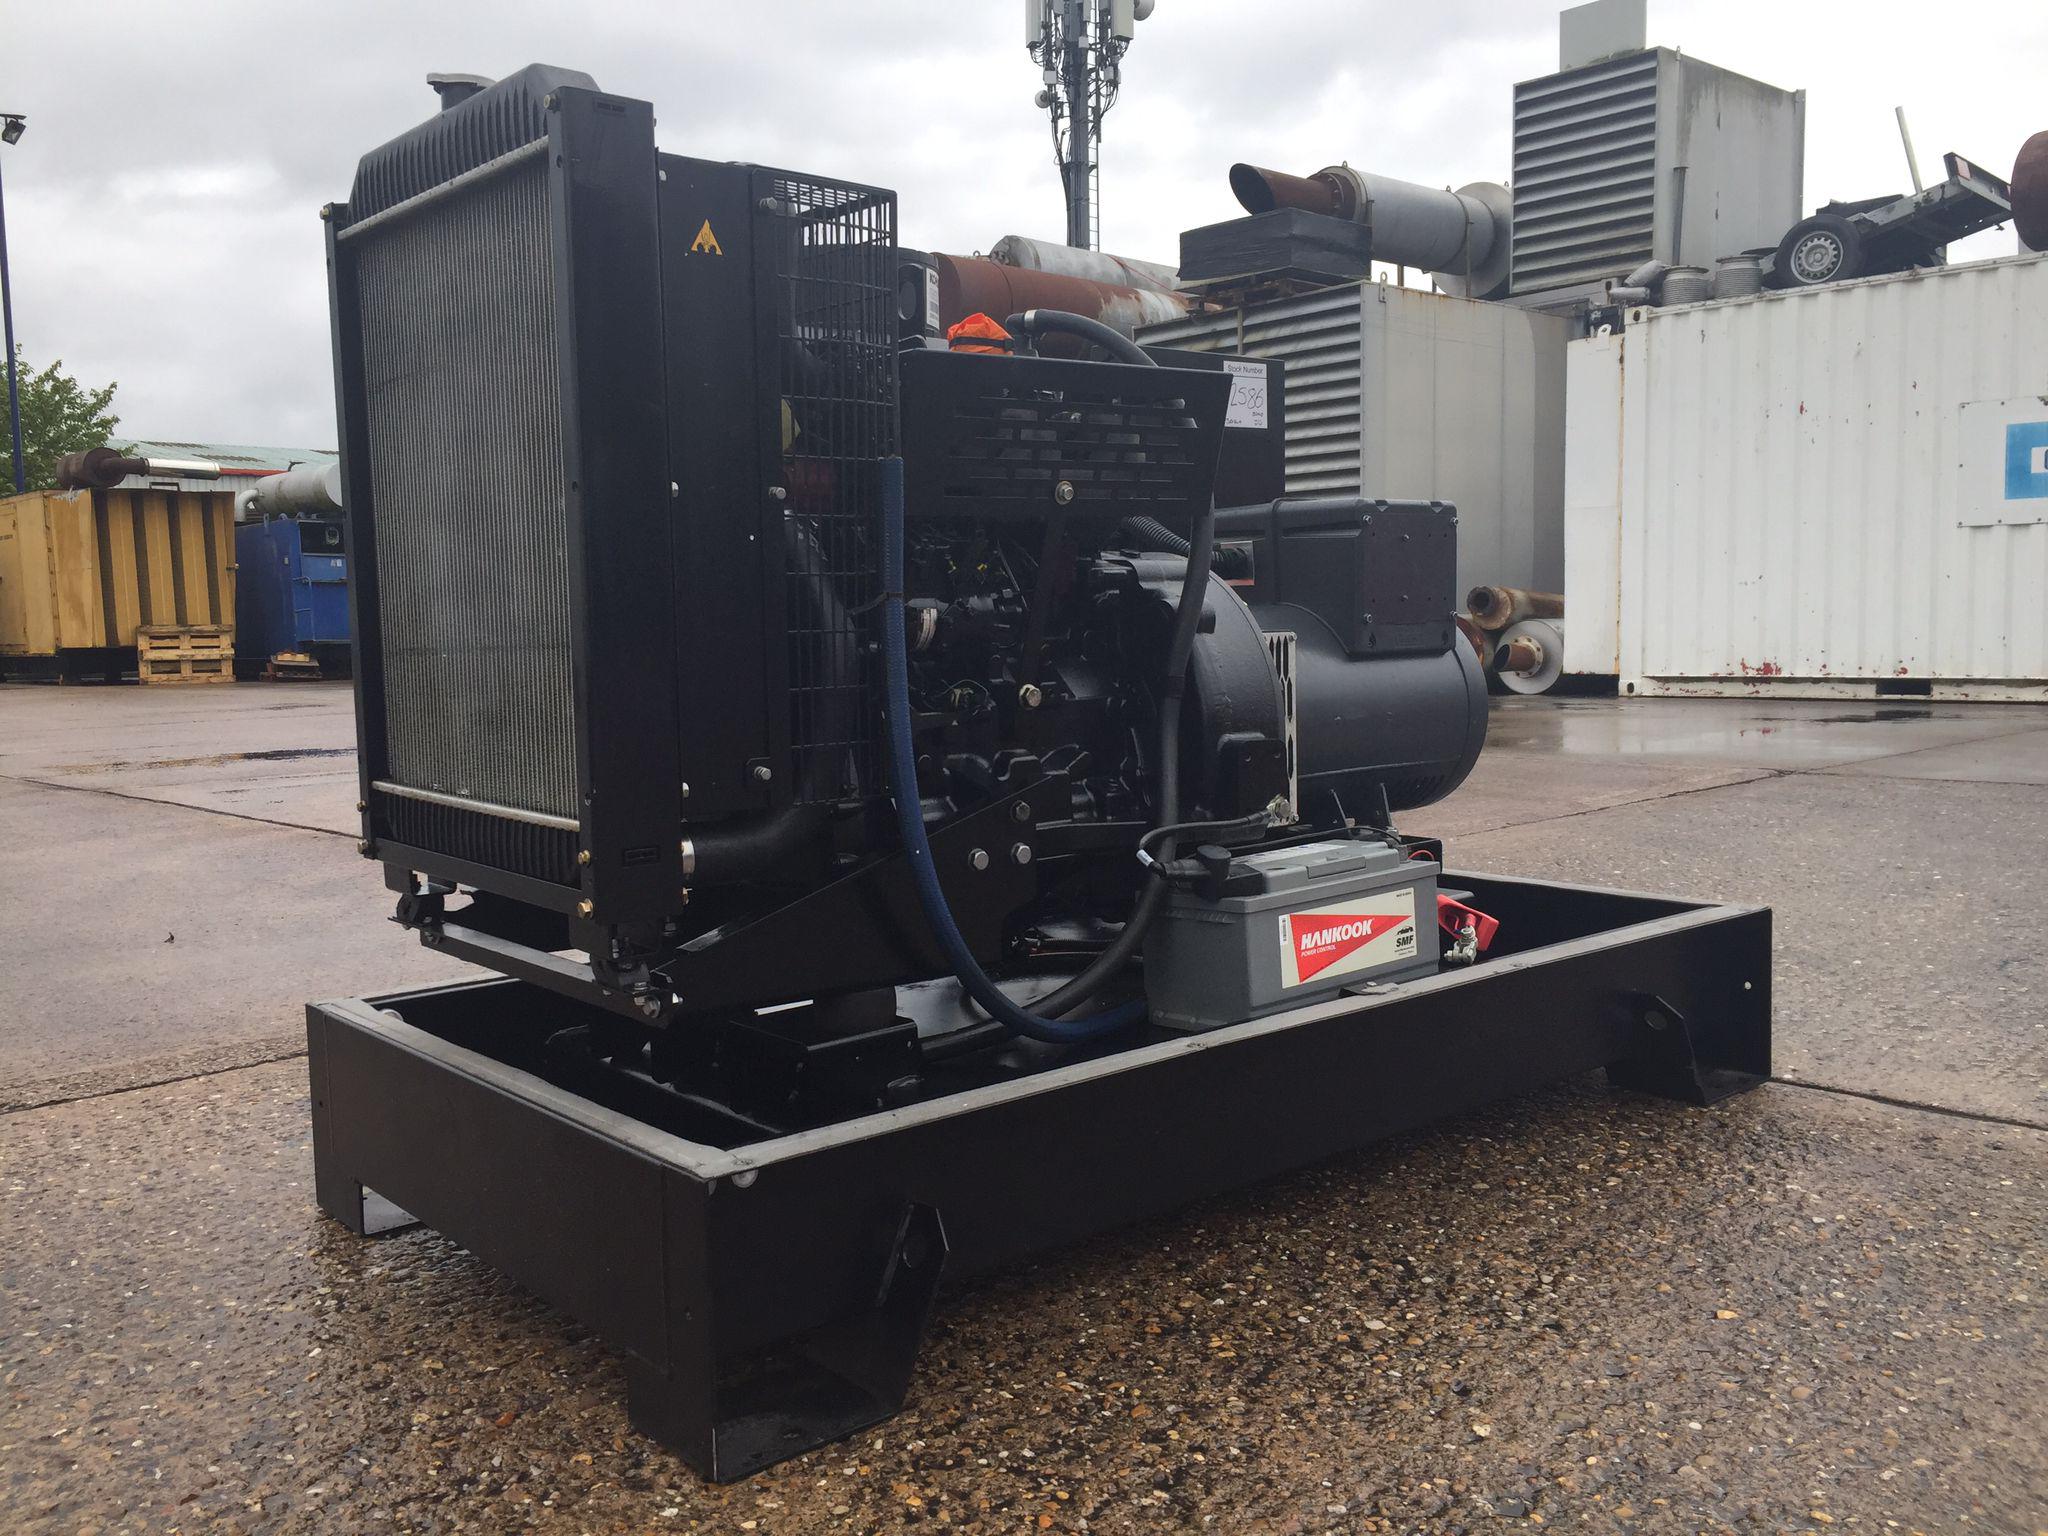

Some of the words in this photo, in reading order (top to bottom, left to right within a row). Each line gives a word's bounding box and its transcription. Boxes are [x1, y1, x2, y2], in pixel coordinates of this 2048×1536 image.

[1228, 364, 1242, 373] Stock
[1243, 366, 1263, 374] Number
[1301, 919, 1373, 950] HANKOOK
[1396, 935, 1414, 947] SMF
[1301, 948, 1317, 957] POWER
[1317, 944, 1336, 954] CONTROL
